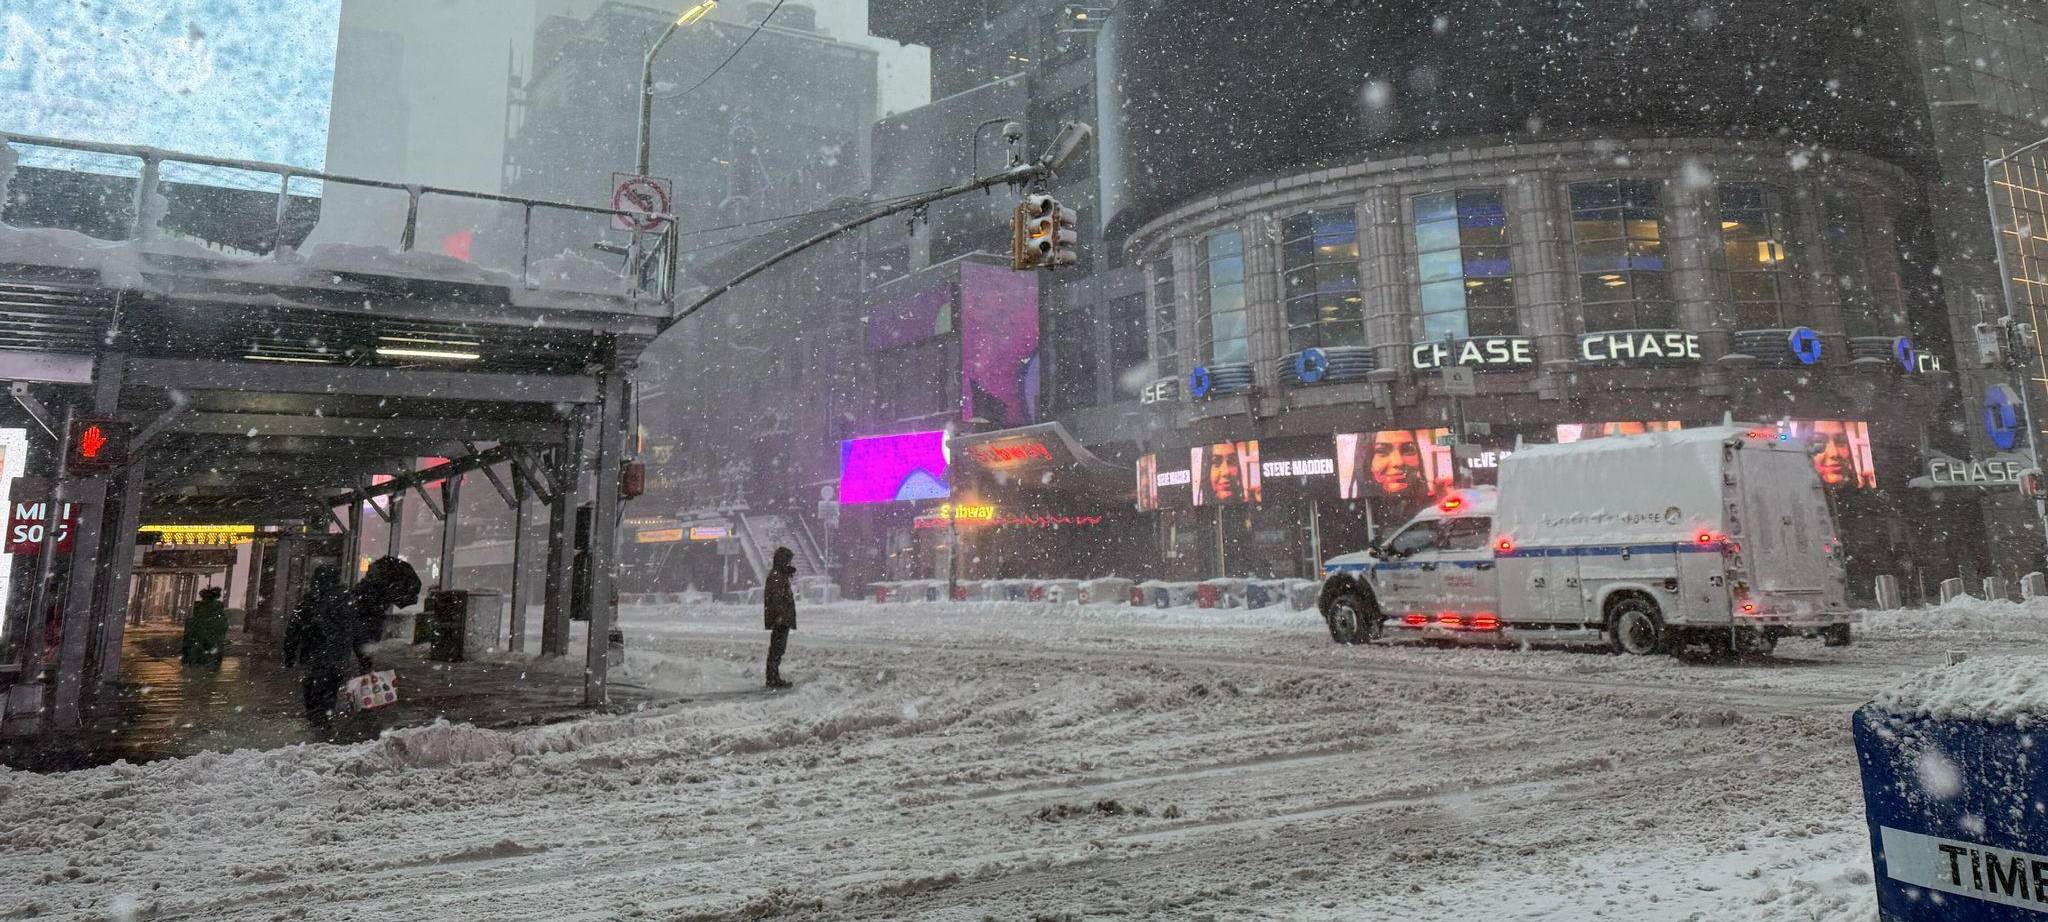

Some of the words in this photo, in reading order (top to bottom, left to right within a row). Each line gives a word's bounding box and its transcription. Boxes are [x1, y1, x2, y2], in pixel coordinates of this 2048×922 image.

[1582, 333, 1702, 361] CHASE
[1263, 462, 1292, 477] STEVE
[1292, 459, 1334, 475] MADDEN
[1931, 462, 2019, 483] CHASE
[15, 503, 71, 520] MII
[1939, 844, 2048, 904] TIME
